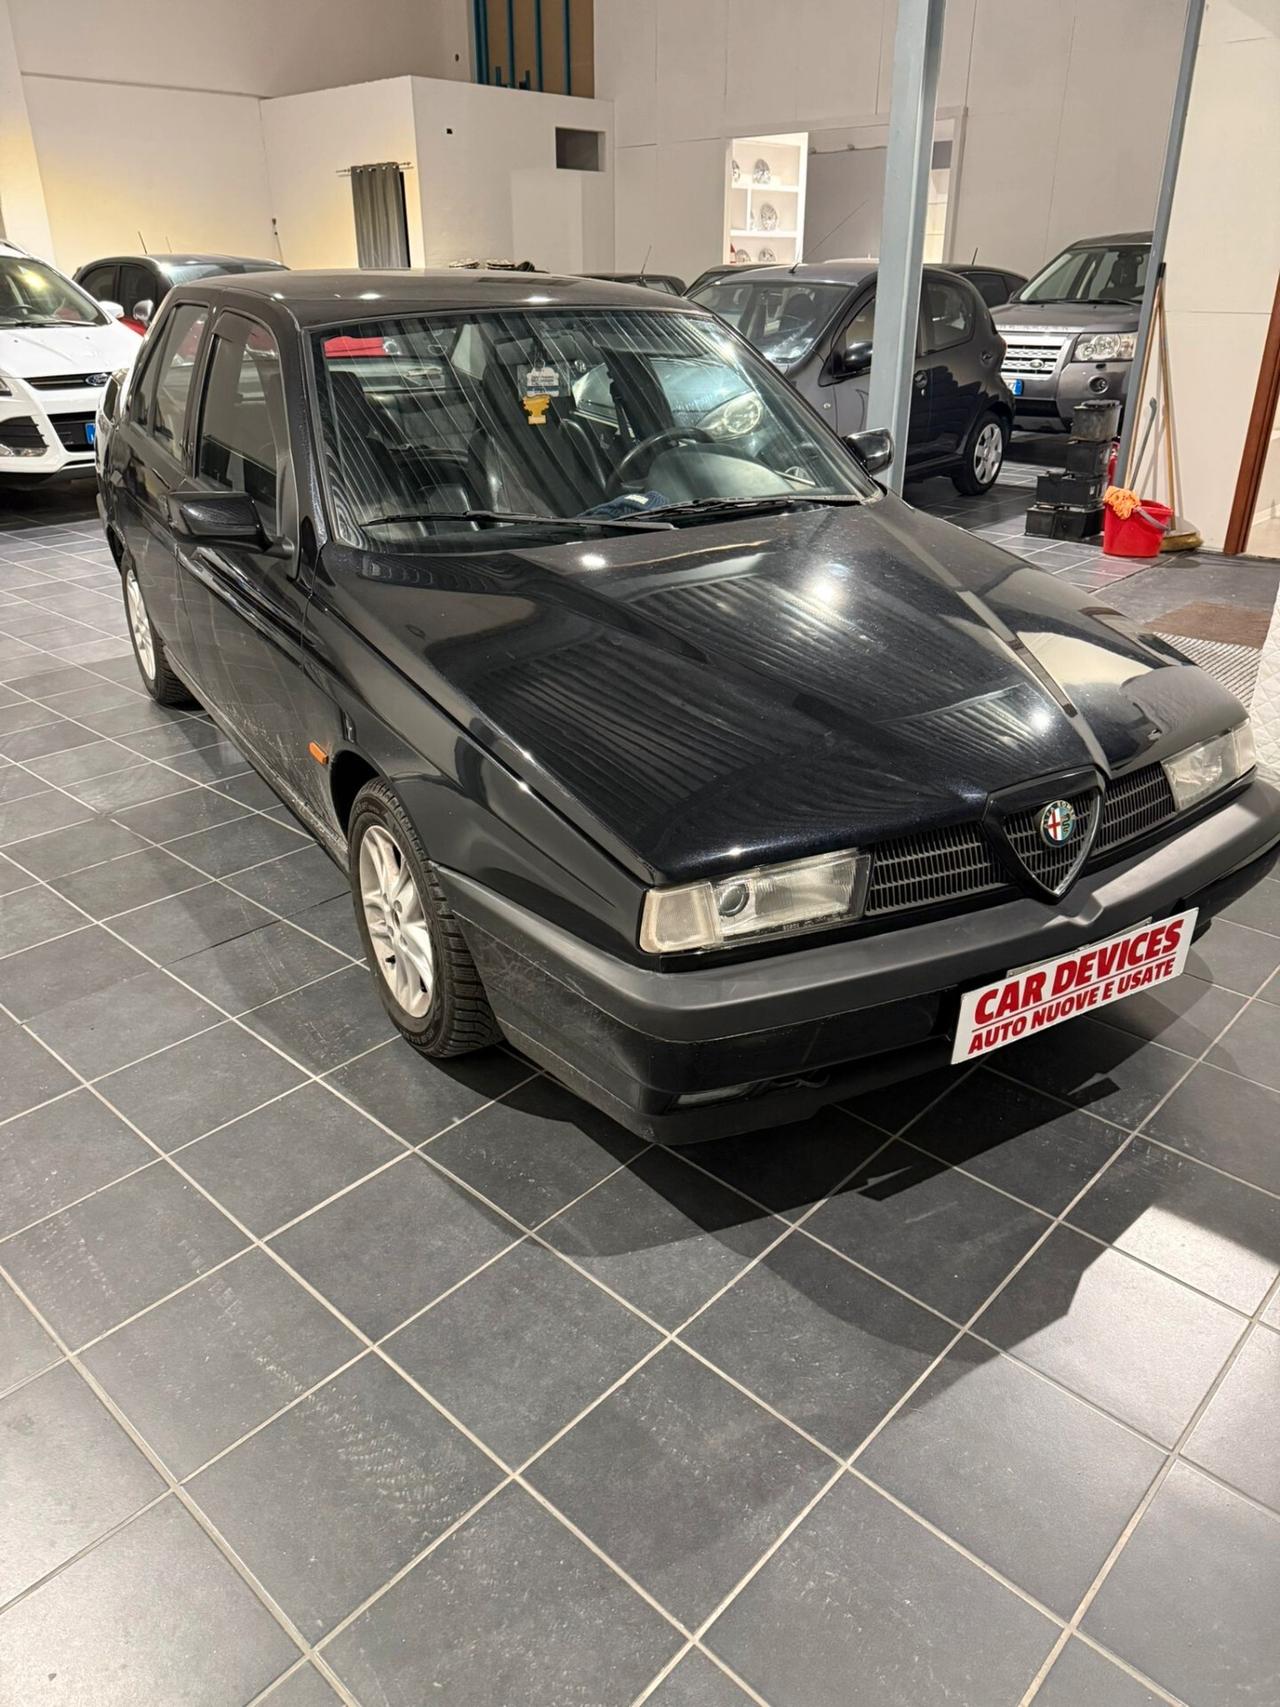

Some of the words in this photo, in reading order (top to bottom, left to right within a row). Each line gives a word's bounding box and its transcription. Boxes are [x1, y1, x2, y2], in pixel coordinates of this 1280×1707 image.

[968, 1016, 1027, 1055] AUTO
[1031, 985, 1098, 1030] NUOVE
[1102, 980, 1114, 1000] E
[1118, 957, 1176, 994] USATE
[975, 971, 1047, 1026] CAR
[1051, 919, 1184, 997] DEVICES
